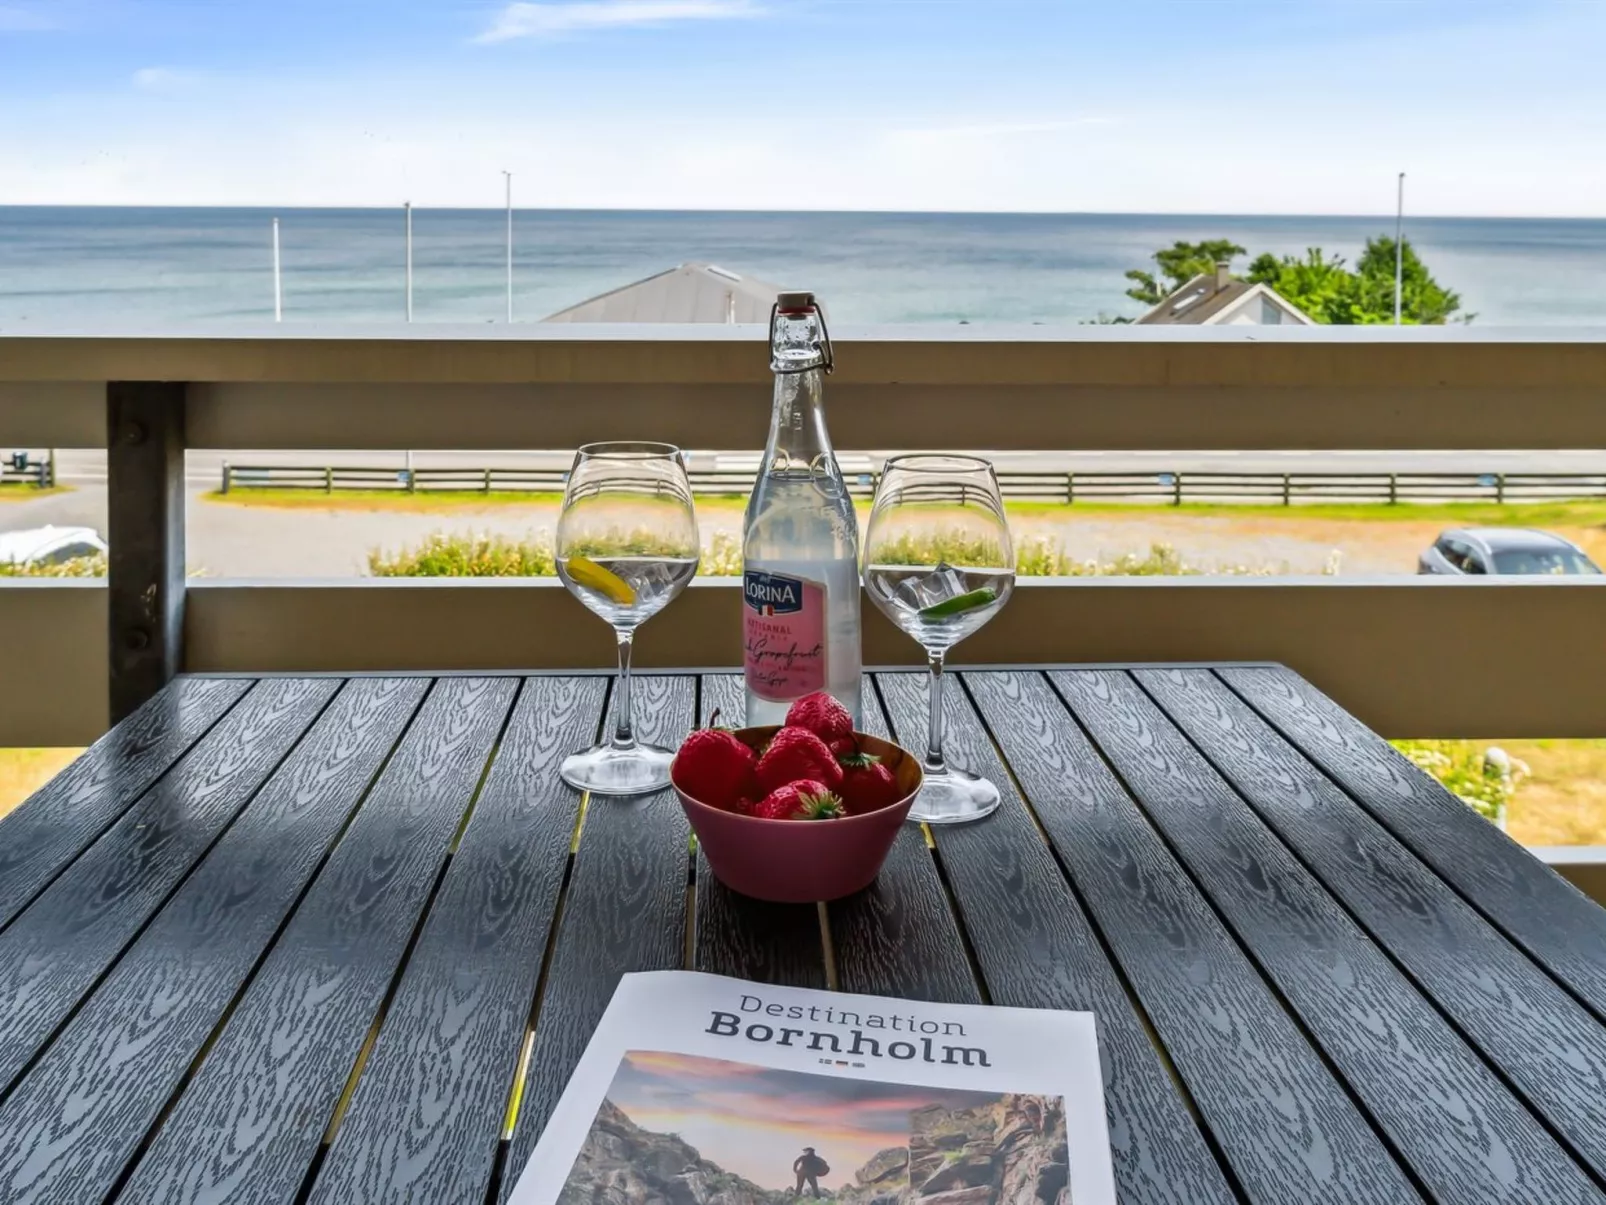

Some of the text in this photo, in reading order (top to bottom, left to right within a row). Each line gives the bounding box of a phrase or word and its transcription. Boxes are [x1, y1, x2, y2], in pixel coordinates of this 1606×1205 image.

[746, 576, 796, 604] LORINA
[740, 995, 967, 1036] Destination
[705, 1011, 992, 1067] Bornholm
